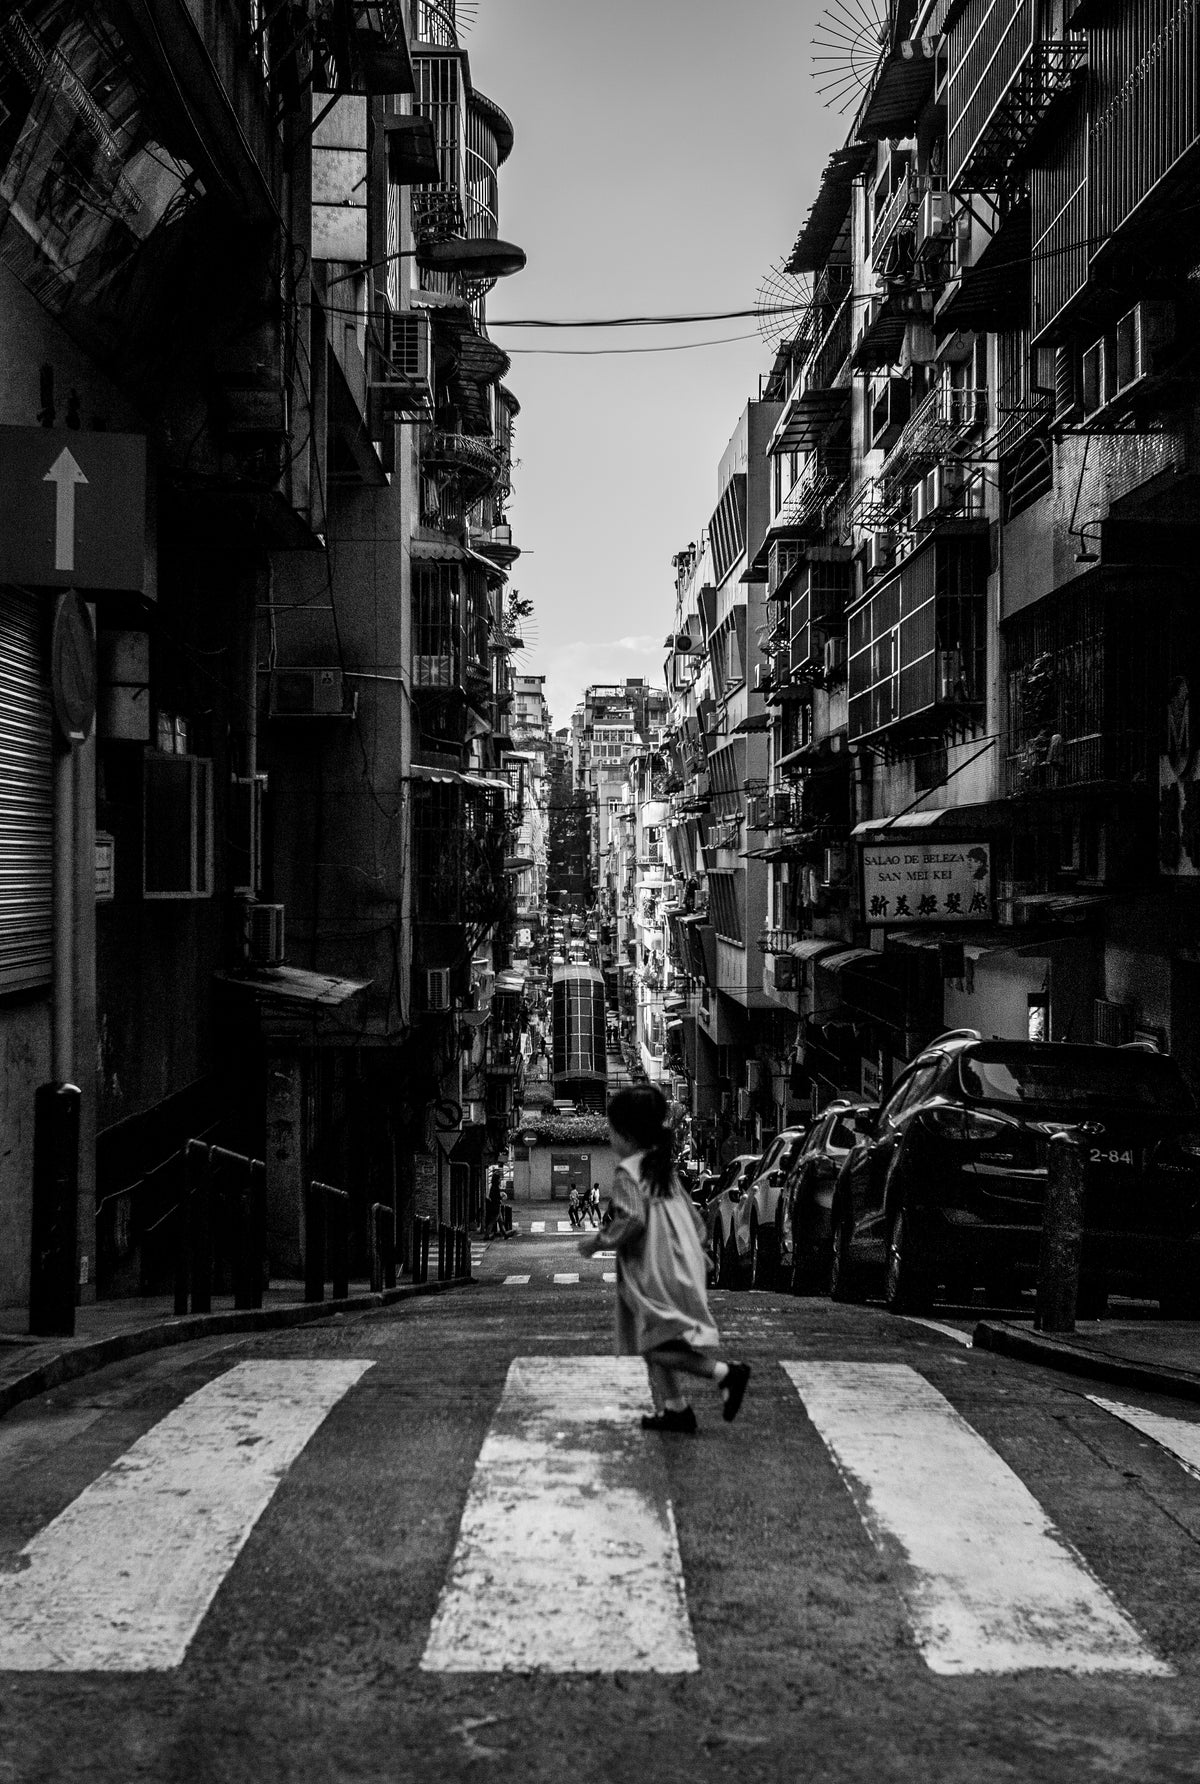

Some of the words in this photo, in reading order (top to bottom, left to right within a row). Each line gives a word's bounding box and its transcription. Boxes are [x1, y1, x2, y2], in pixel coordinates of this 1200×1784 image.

[904, 855, 919, 864] DE
[923, 853, 965, 864] BELEZA
[878, 872, 902, 882] SAN
[906, 870, 929, 881] MEI
[933, 870, 952, 880] KEI
